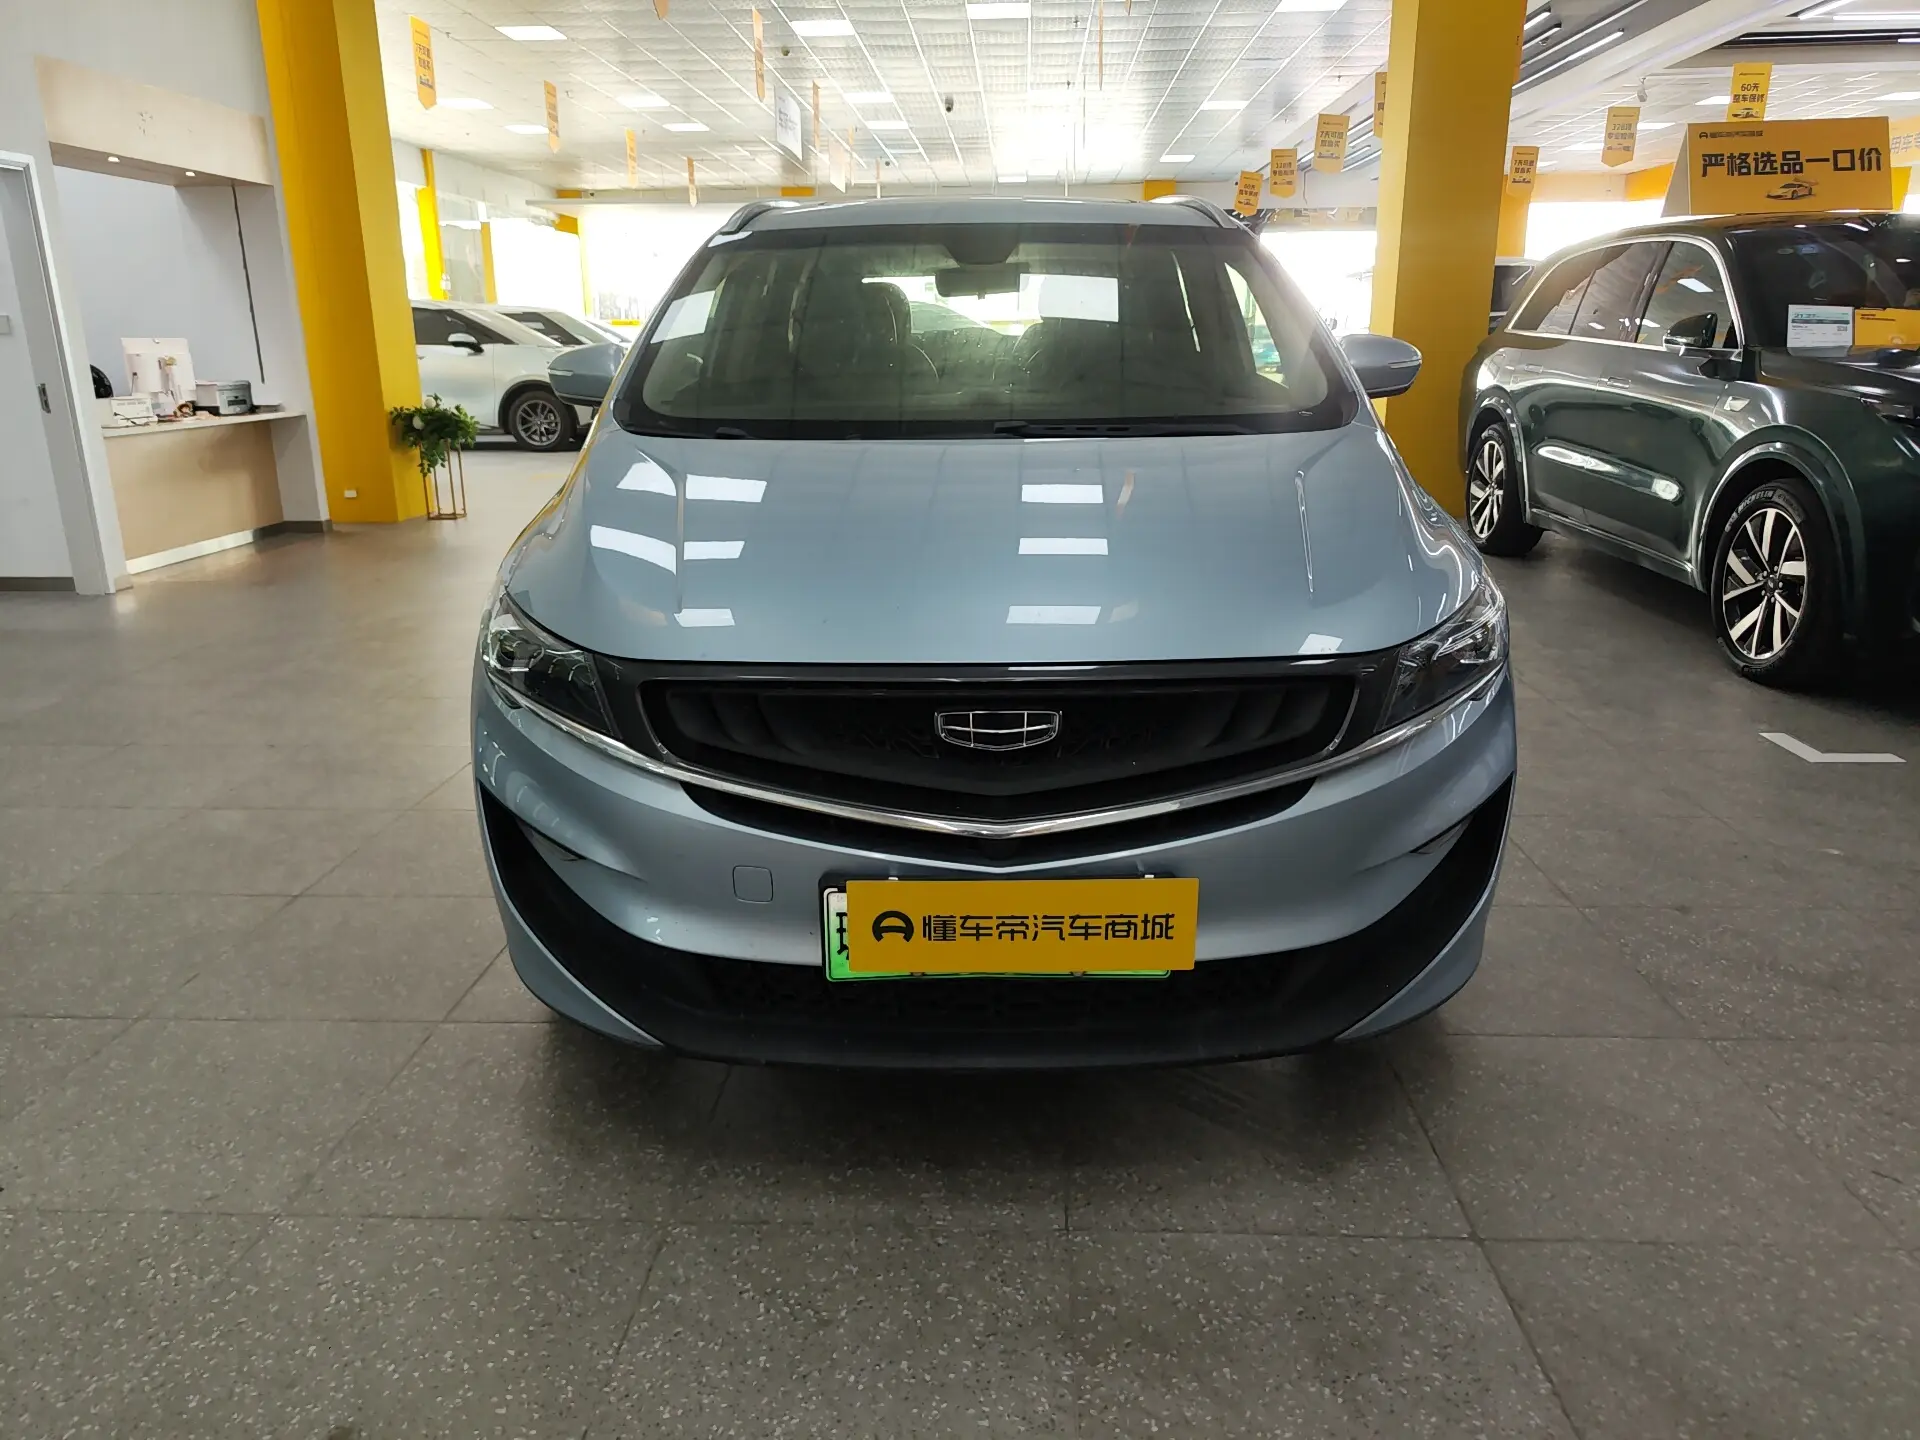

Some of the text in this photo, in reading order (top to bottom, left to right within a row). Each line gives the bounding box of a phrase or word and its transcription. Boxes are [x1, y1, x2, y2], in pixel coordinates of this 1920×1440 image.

[1740, 82, 1760, 92] 60天
[1701, 147, 1882, 178] 严格选品一口价
[921, 912, 1175, 942] 懂车帝汽车商城
